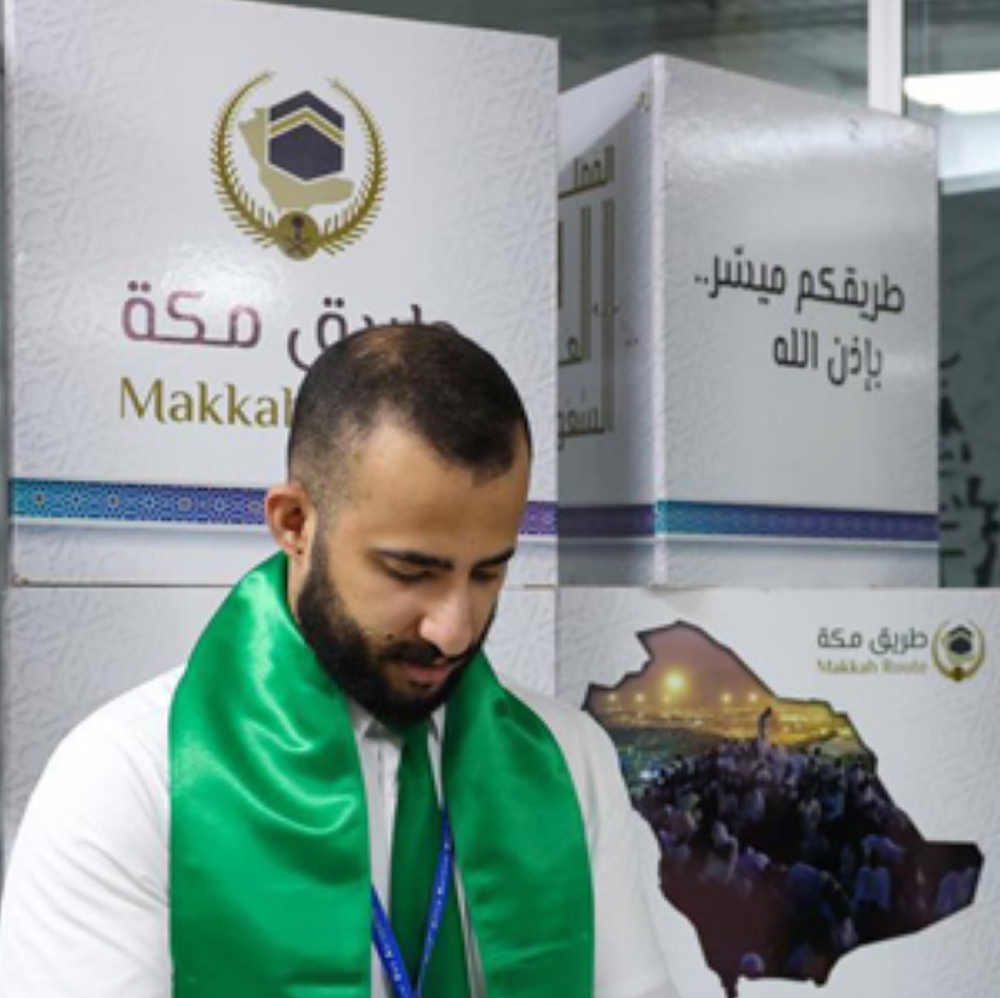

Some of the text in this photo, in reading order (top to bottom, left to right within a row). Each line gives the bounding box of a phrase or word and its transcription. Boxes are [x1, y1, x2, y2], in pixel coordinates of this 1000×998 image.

[122, 280, 262, 349] مكة
[795, 266, 905, 323] طريقكم
[773, 327, 882, 392] بإذن الله
[817, 625, 929, 655] طريق مكة
